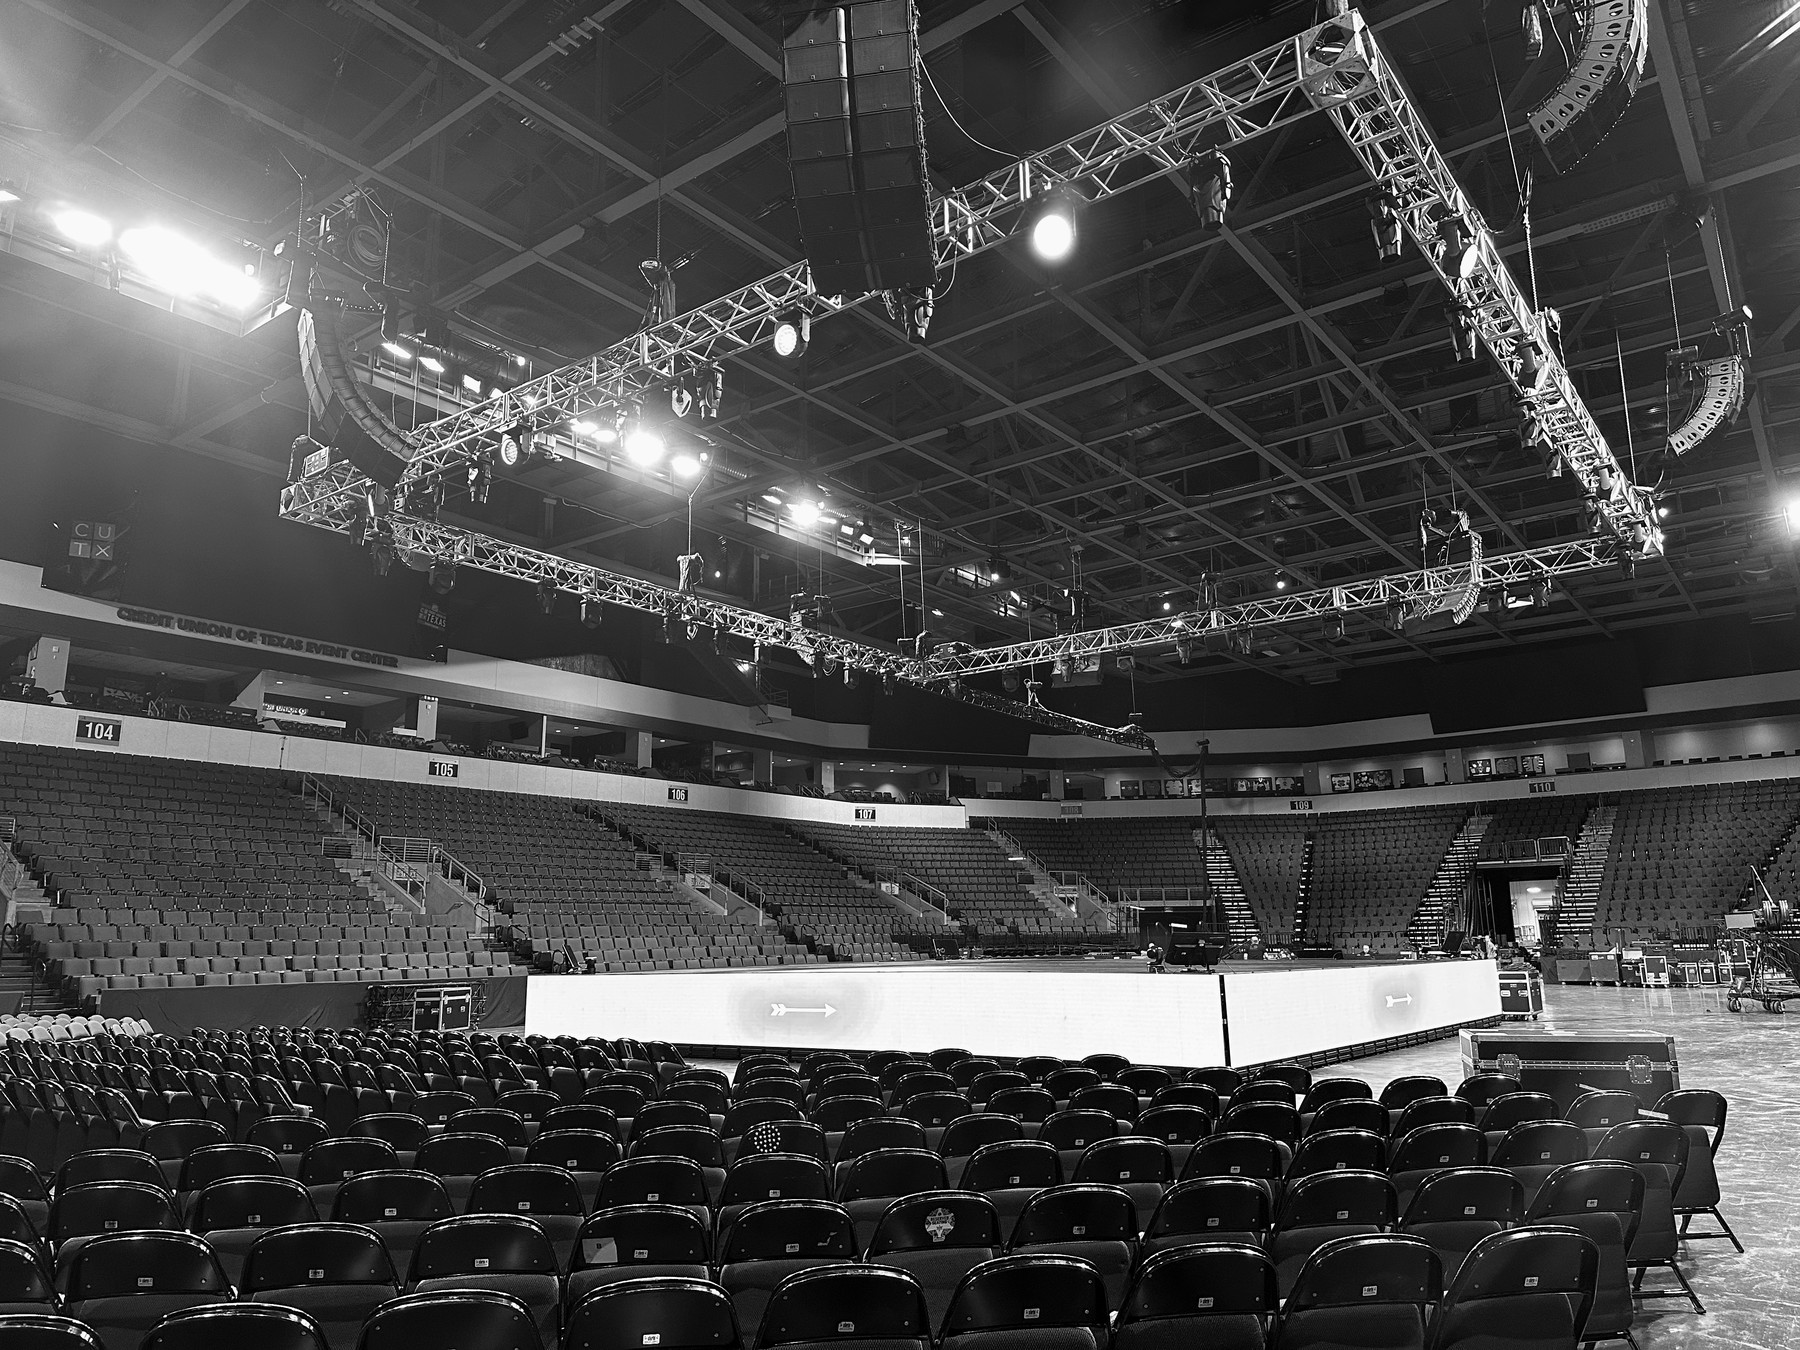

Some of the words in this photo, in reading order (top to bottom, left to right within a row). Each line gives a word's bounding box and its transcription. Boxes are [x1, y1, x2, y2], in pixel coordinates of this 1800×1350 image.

[426, 613, 446, 628] TEXAS
[117, 607, 174, 629] CREDIT
[177, 618, 232, 638] UNION
[235, 629, 257, 643] OF
[259, 633, 303, 651] TEXAS
[305, 642, 348, 658] EVENT
[350, 650, 398, 668] CENTER
[85, 722, 113, 740] 104
[434, 762, 454, 777] 105
[671, 788, 685, 801] 106
[1533, 782, 1551, 793] 110
[1294, 801, 1309, 810] 109
[858, 809, 873, 819] 107
